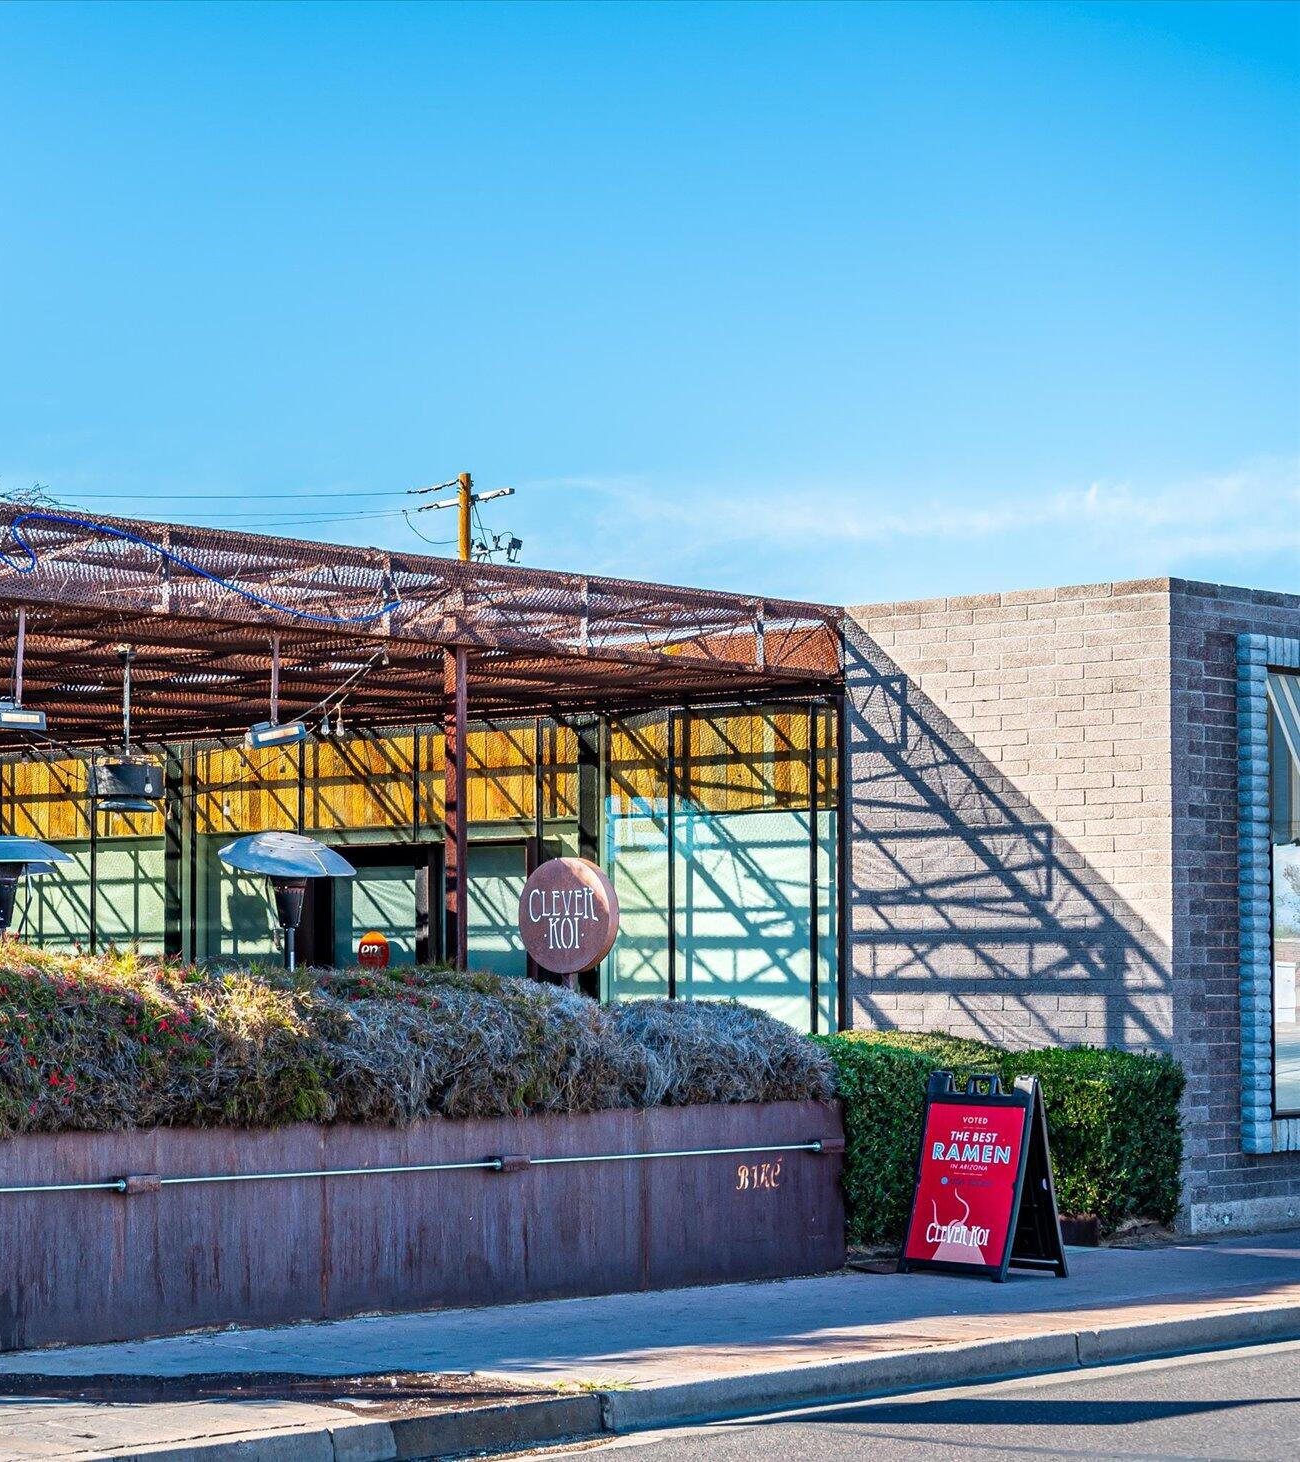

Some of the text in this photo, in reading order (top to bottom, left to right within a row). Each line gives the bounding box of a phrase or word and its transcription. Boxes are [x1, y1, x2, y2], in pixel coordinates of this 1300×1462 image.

[529, 888, 599, 923] CLEVER
[548, 917, 581, 950] KOI
[962, 1116, 989, 1125] VOTED
[950, 1131, 998, 1143] THE BEST
[932, 1142, 1011, 1164] RAMEN
[926, 1222, 990, 1247] CLEVER KOI
